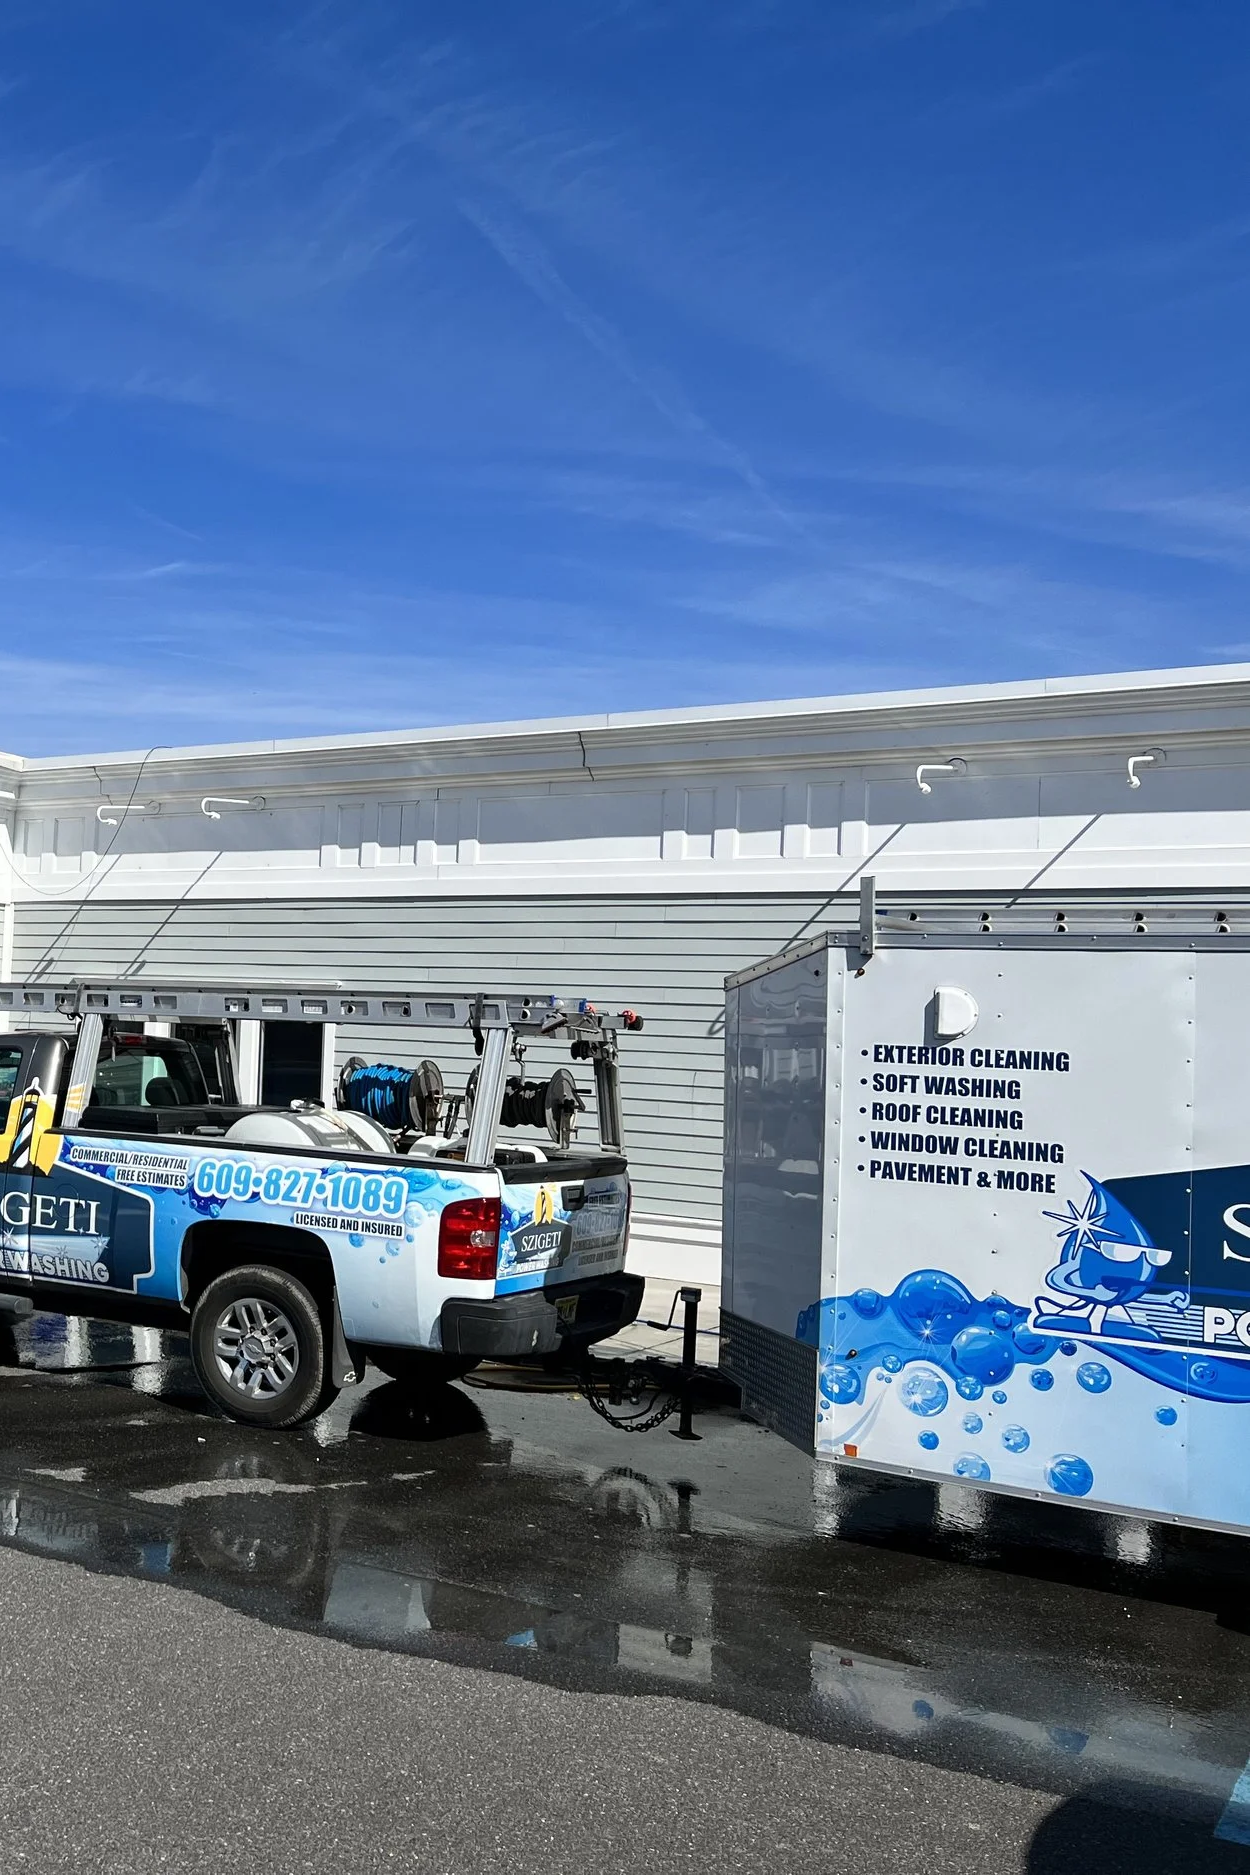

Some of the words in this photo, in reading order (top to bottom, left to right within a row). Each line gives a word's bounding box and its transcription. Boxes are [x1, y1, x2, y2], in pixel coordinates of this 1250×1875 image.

[873, 1044, 964, 1067] EXTERIOR
[970, 1048, 1070, 1072] CLEANING
[872, 1073, 920, 1093] SOFT
[924, 1076, 1021, 1100] WASHING
[872, 1102, 921, 1123] ROOF
[926, 1105, 1023, 1130] CLEANING
[71, 1147, 188, 1171] COMMERCIAL/RESIDENTIAL
[870, 1131, 959, 1155] WINDOW
[964, 1137, 1064, 1164] CLEANING
[116, 1168, 135, 1181] FREE
[136, 1170, 186, 1187] ESTIMATES
[869, 1160, 972, 1186] PAVEMENT
[976, 1171, 991, 1188] &
[996, 1169, 1056, 1193] MORE
[295, 1213, 338, 1230] LICENSED
[339, 1216, 359, 1231] AND
[360, 1219, 403, 1237] INSURED
[521, 1230, 562, 1252] SZIGETI
[8, 1250, 110, 1284] WASHING
